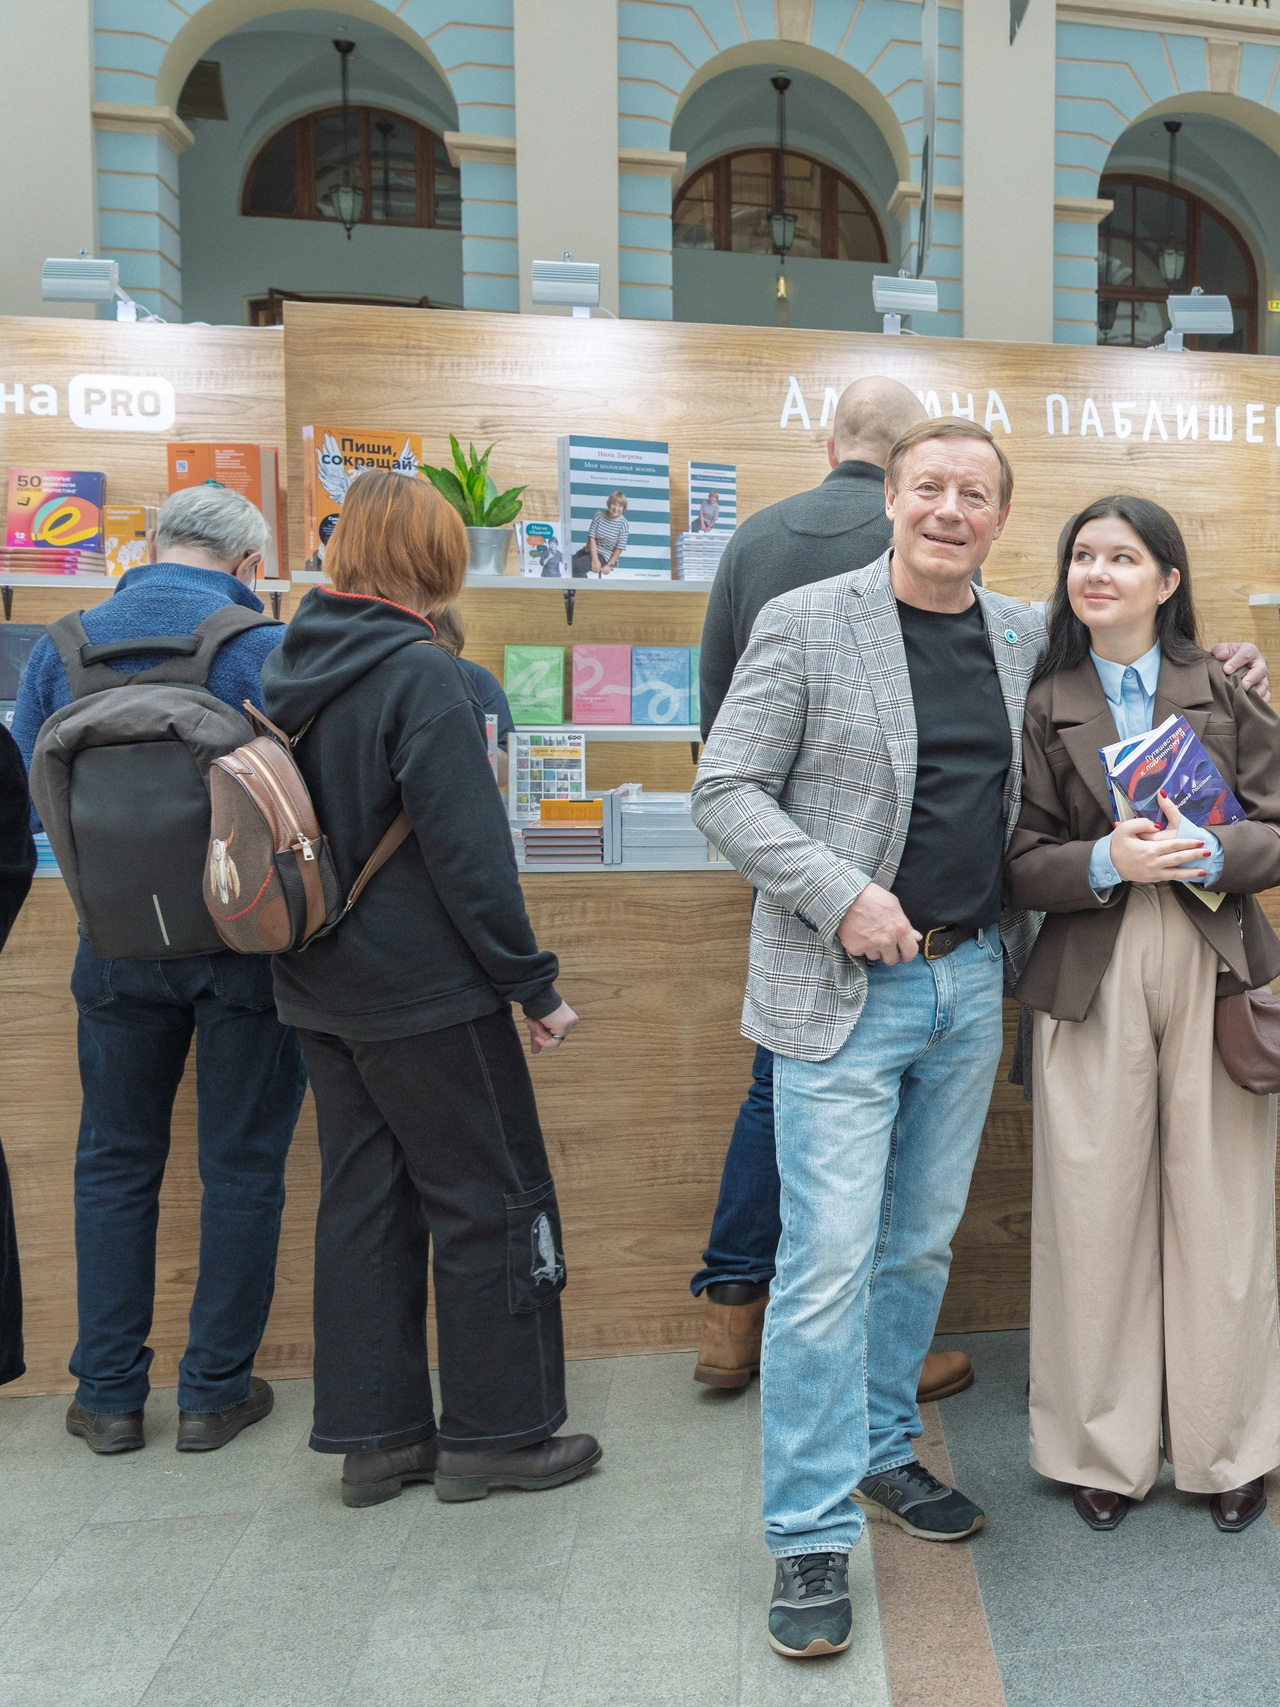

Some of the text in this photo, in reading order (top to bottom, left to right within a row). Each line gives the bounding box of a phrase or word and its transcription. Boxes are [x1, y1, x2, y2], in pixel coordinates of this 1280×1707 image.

[84, 387, 161, 417] PRO
[780, 375, 1012, 434] АЛИНА
[341, 438, 397, 457] Пиши,
[321, 454, 413, 471] сокращай
[17, 475, 41, 487] 50
[1144, 727, 1183, 762] Путешествие
